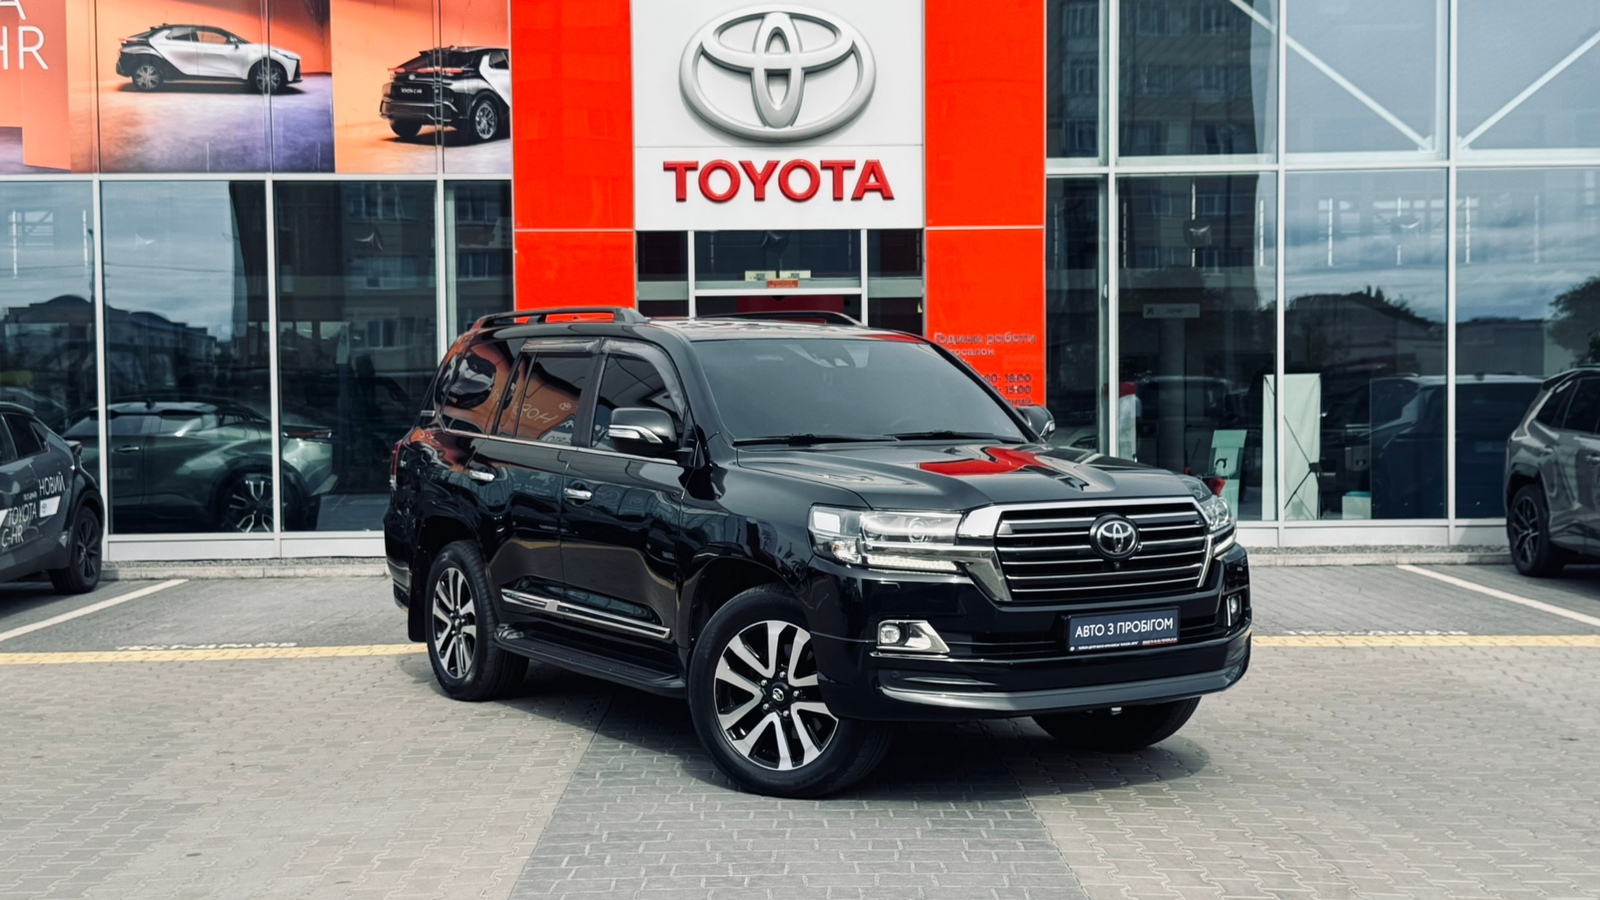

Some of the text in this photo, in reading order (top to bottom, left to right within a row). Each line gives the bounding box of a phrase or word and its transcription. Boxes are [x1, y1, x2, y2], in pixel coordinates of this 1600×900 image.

[663, 159, 895, 203] TOYOTA
[934, 331, 1036, 345] Години роботи
[38, 471, 66, 496] НОВИЙ
[8, 502, 37, 526] TOYOTA
[1, 524, 24, 548] C-HR
[1075, 623, 1105, 638] АВТО
[1116, 617, 1174, 634] ПРОБІГОМ
